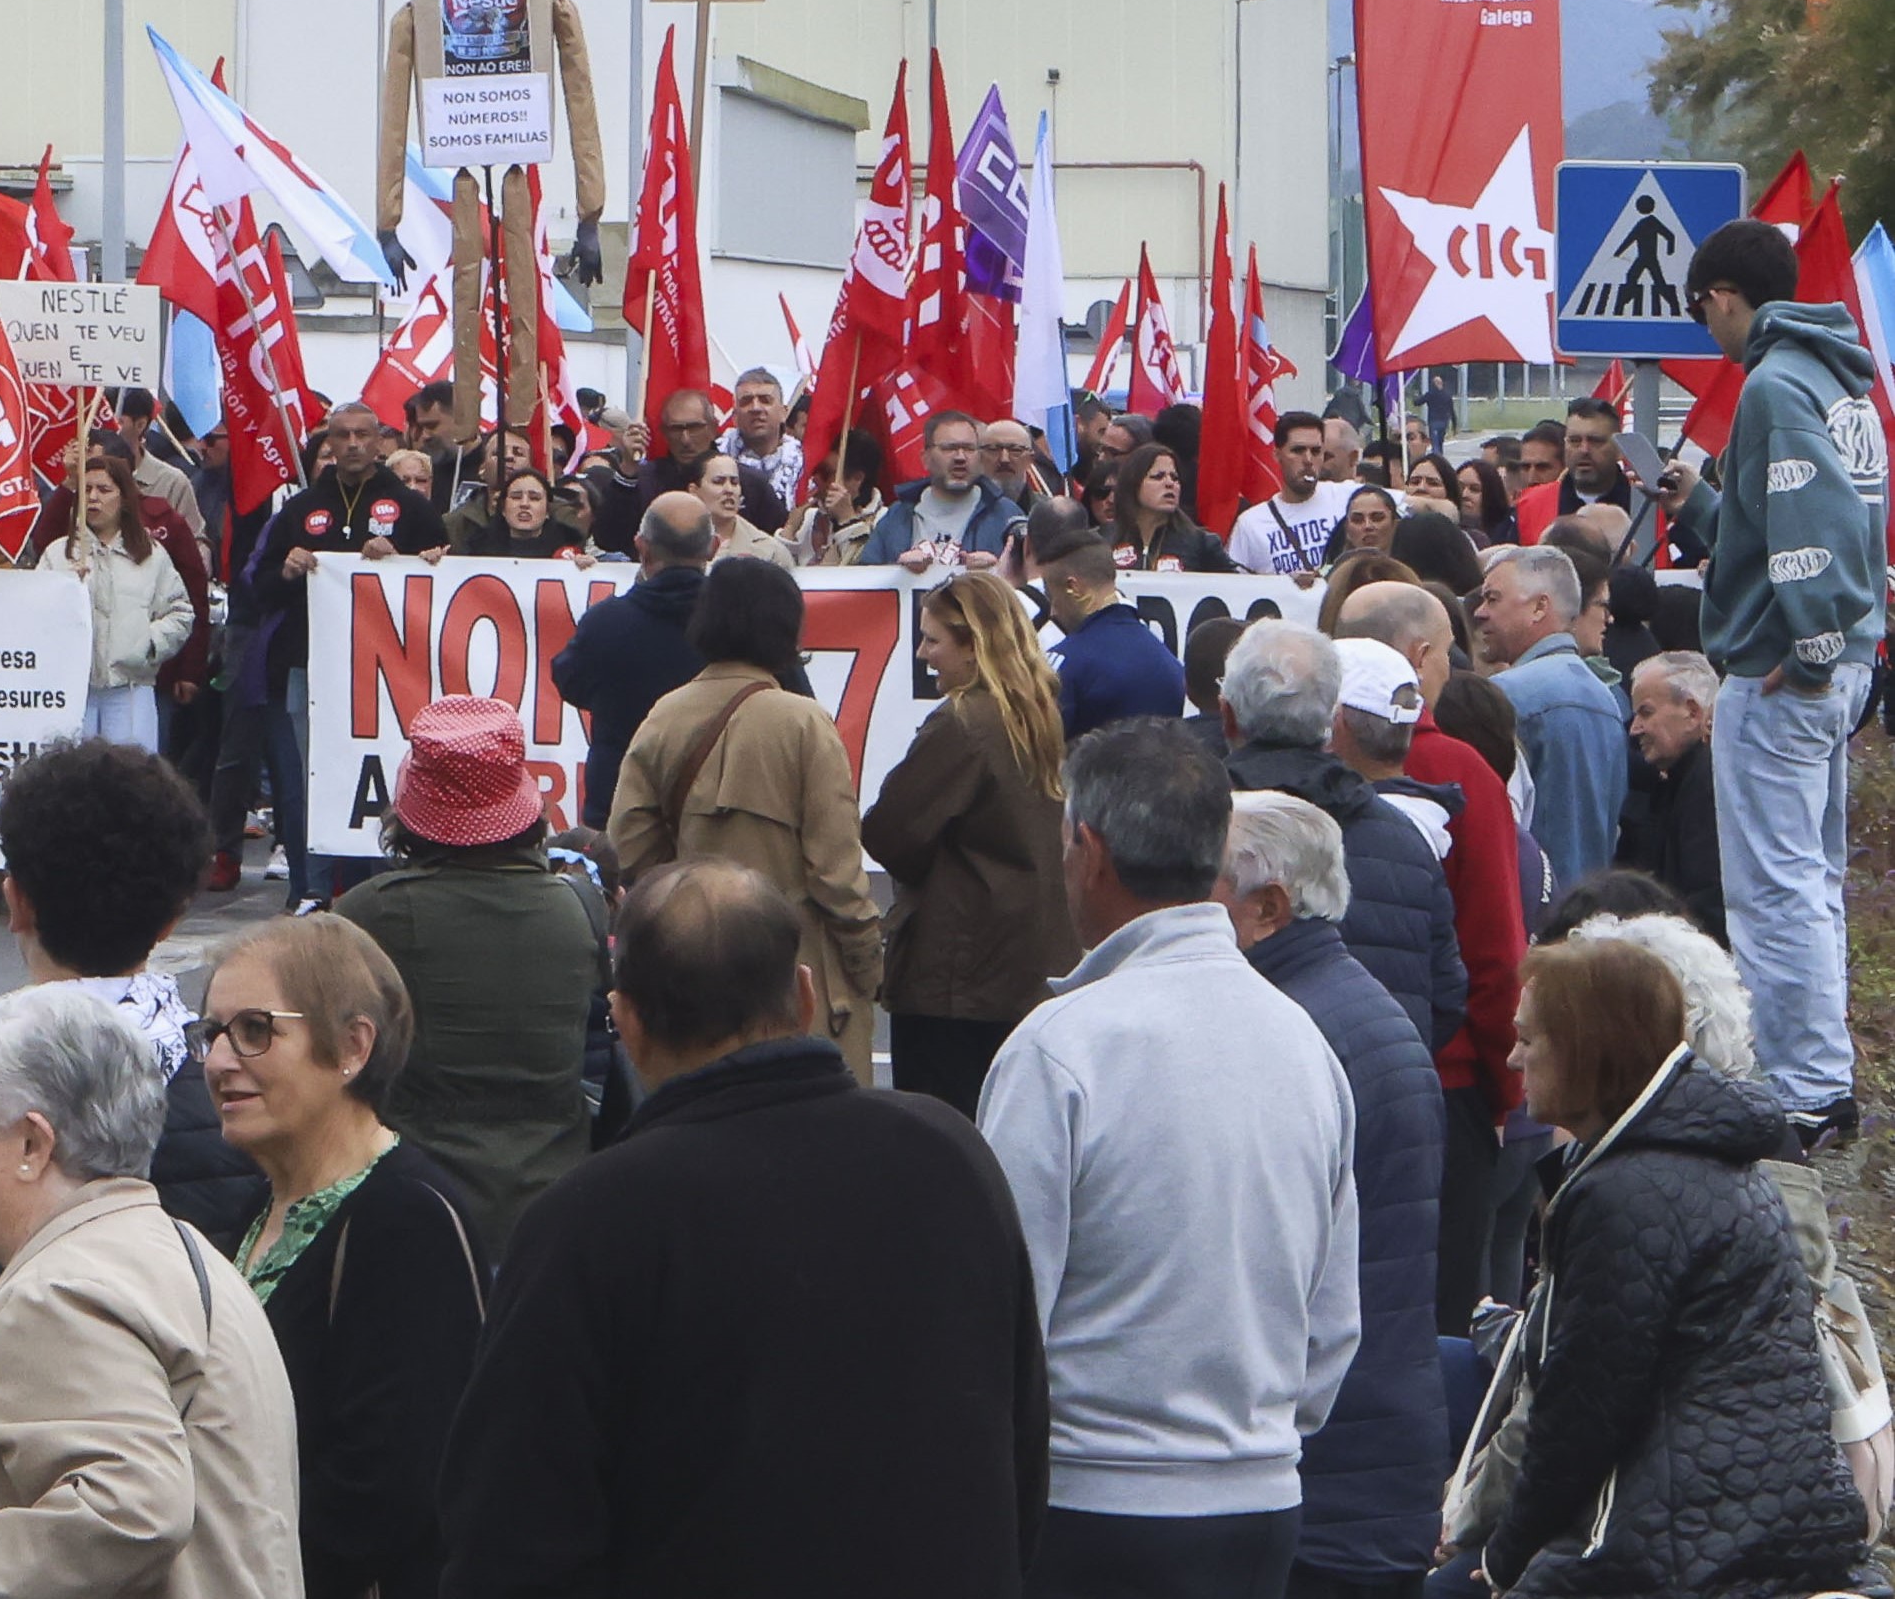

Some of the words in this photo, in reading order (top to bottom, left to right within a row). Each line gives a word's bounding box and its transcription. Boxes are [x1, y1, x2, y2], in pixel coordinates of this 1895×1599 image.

[1480, 8, 1533, 28] Galega
[445, 63, 476, 76] NON
[477, 61, 497, 74] AO
[443, 91, 475, 105] NON
[479, 89, 531, 103] SOMOS
[448, 111, 527, 126] NÚMEROS!!
[429, 134, 481, 148] SOMOS
[485, 130, 548, 146] FAMILIAS
[1447, 223, 1547, 281] CIG
[41, 287, 129, 314] NESTLÉ
[6, 320, 59, 344] QUEN
[75, 325, 99, 341] TE
[108, 325, 146, 343] VEU
[69, 345, 82, 362] E
[78, 364, 103, 382] TE
[116, 366, 143, 383] VE
[256, 434, 290, 481] Agro
[351, 572, 616, 746] NON
